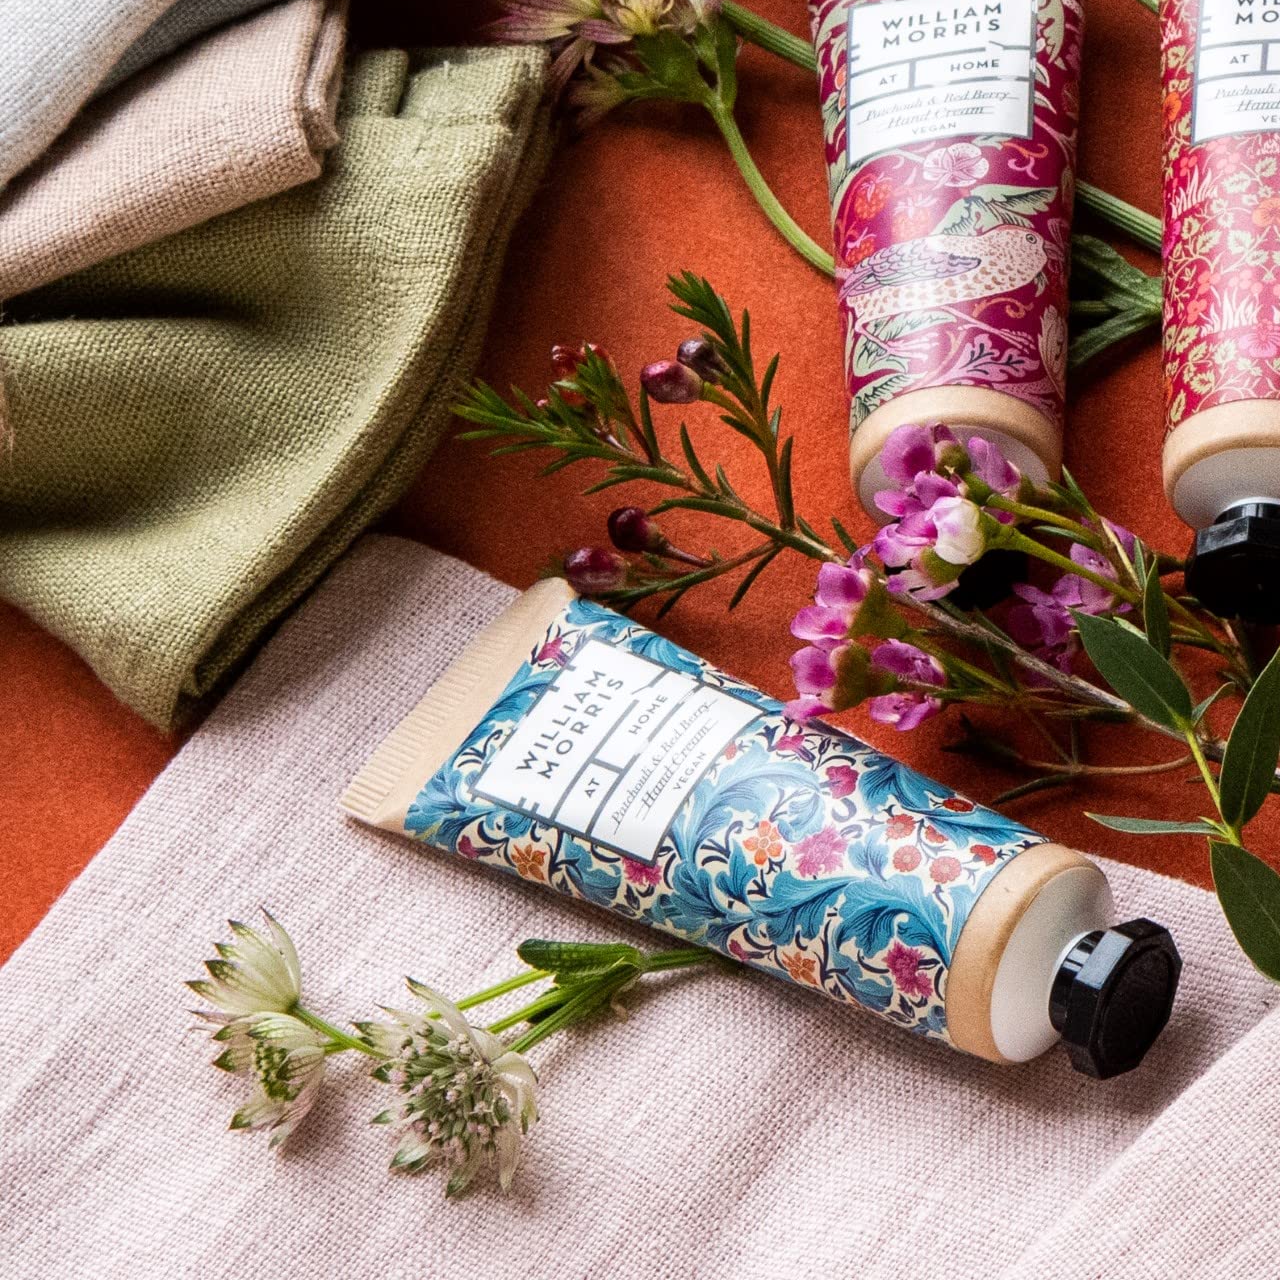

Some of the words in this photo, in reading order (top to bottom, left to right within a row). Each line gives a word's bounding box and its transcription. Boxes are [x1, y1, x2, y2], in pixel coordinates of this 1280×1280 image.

[882, 3, 1002, 32] WILLIAM
[883, 19, 1000, 48] MORRIS
[879, 74, 897, 86] AT
[951, 59, 999, 72] HOME
[1229, 54, 1250, 65] AT
[927, 96, 937, 106] &
[944, 91, 970, 103] Red
[971, 88, 1009, 101] Berry
[1215, 85, 1274, 99] Patchouli
[888, 113, 931, 129] Hand
[935, 107, 985, 120] Cream
[912, 122, 957, 135] VEGAN
[516, 669, 606, 771] WILLIAM
[537, 677, 624, 779] MORRIS
[585, 777, 601, 799] AT
[628, 693, 669, 735] HOME
[611, 769, 651, 827] Patchouli
[664, 730, 681, 759] Red
[681, 702, 710, 728] Berry
[641, 770, 673, 810] Hand
[674, 723, 711, 771] Cream
[673, 751, 706, 791] VEGAN
